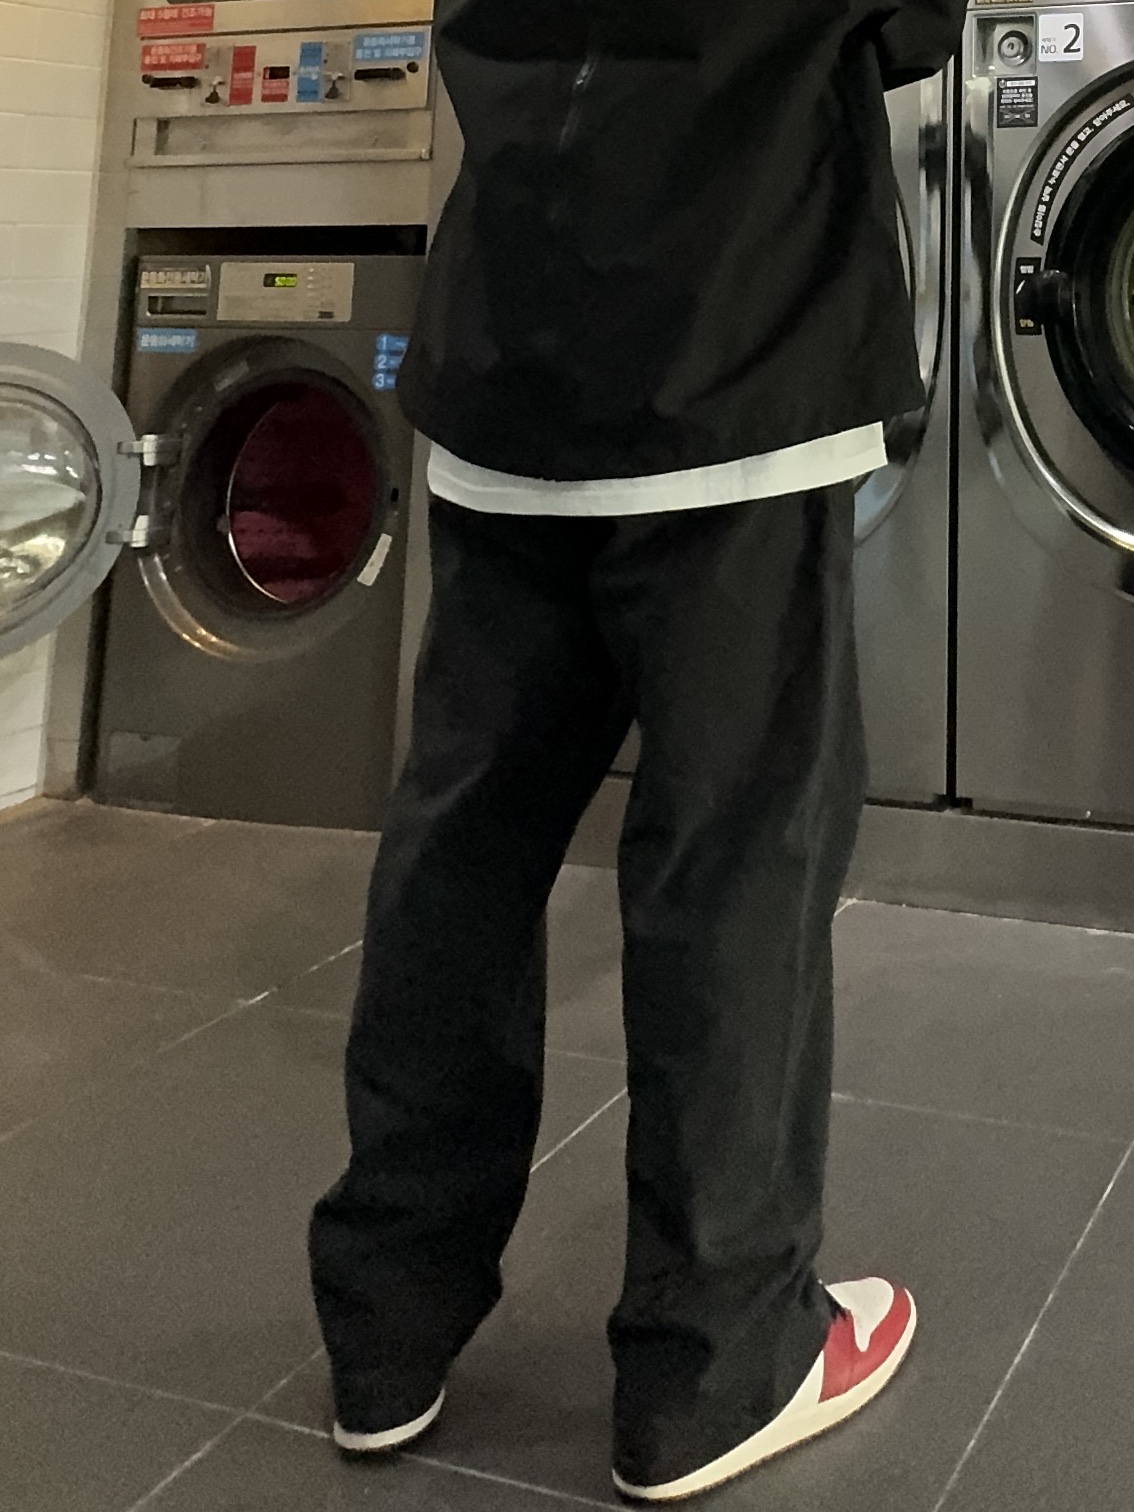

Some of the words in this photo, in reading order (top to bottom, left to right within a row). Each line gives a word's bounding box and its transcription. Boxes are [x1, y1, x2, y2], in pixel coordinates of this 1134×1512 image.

[1041, 44, 1057, 55] NO.
[1063, 23, 1081, 54] 2
[375, 374, 384, 387] 3
